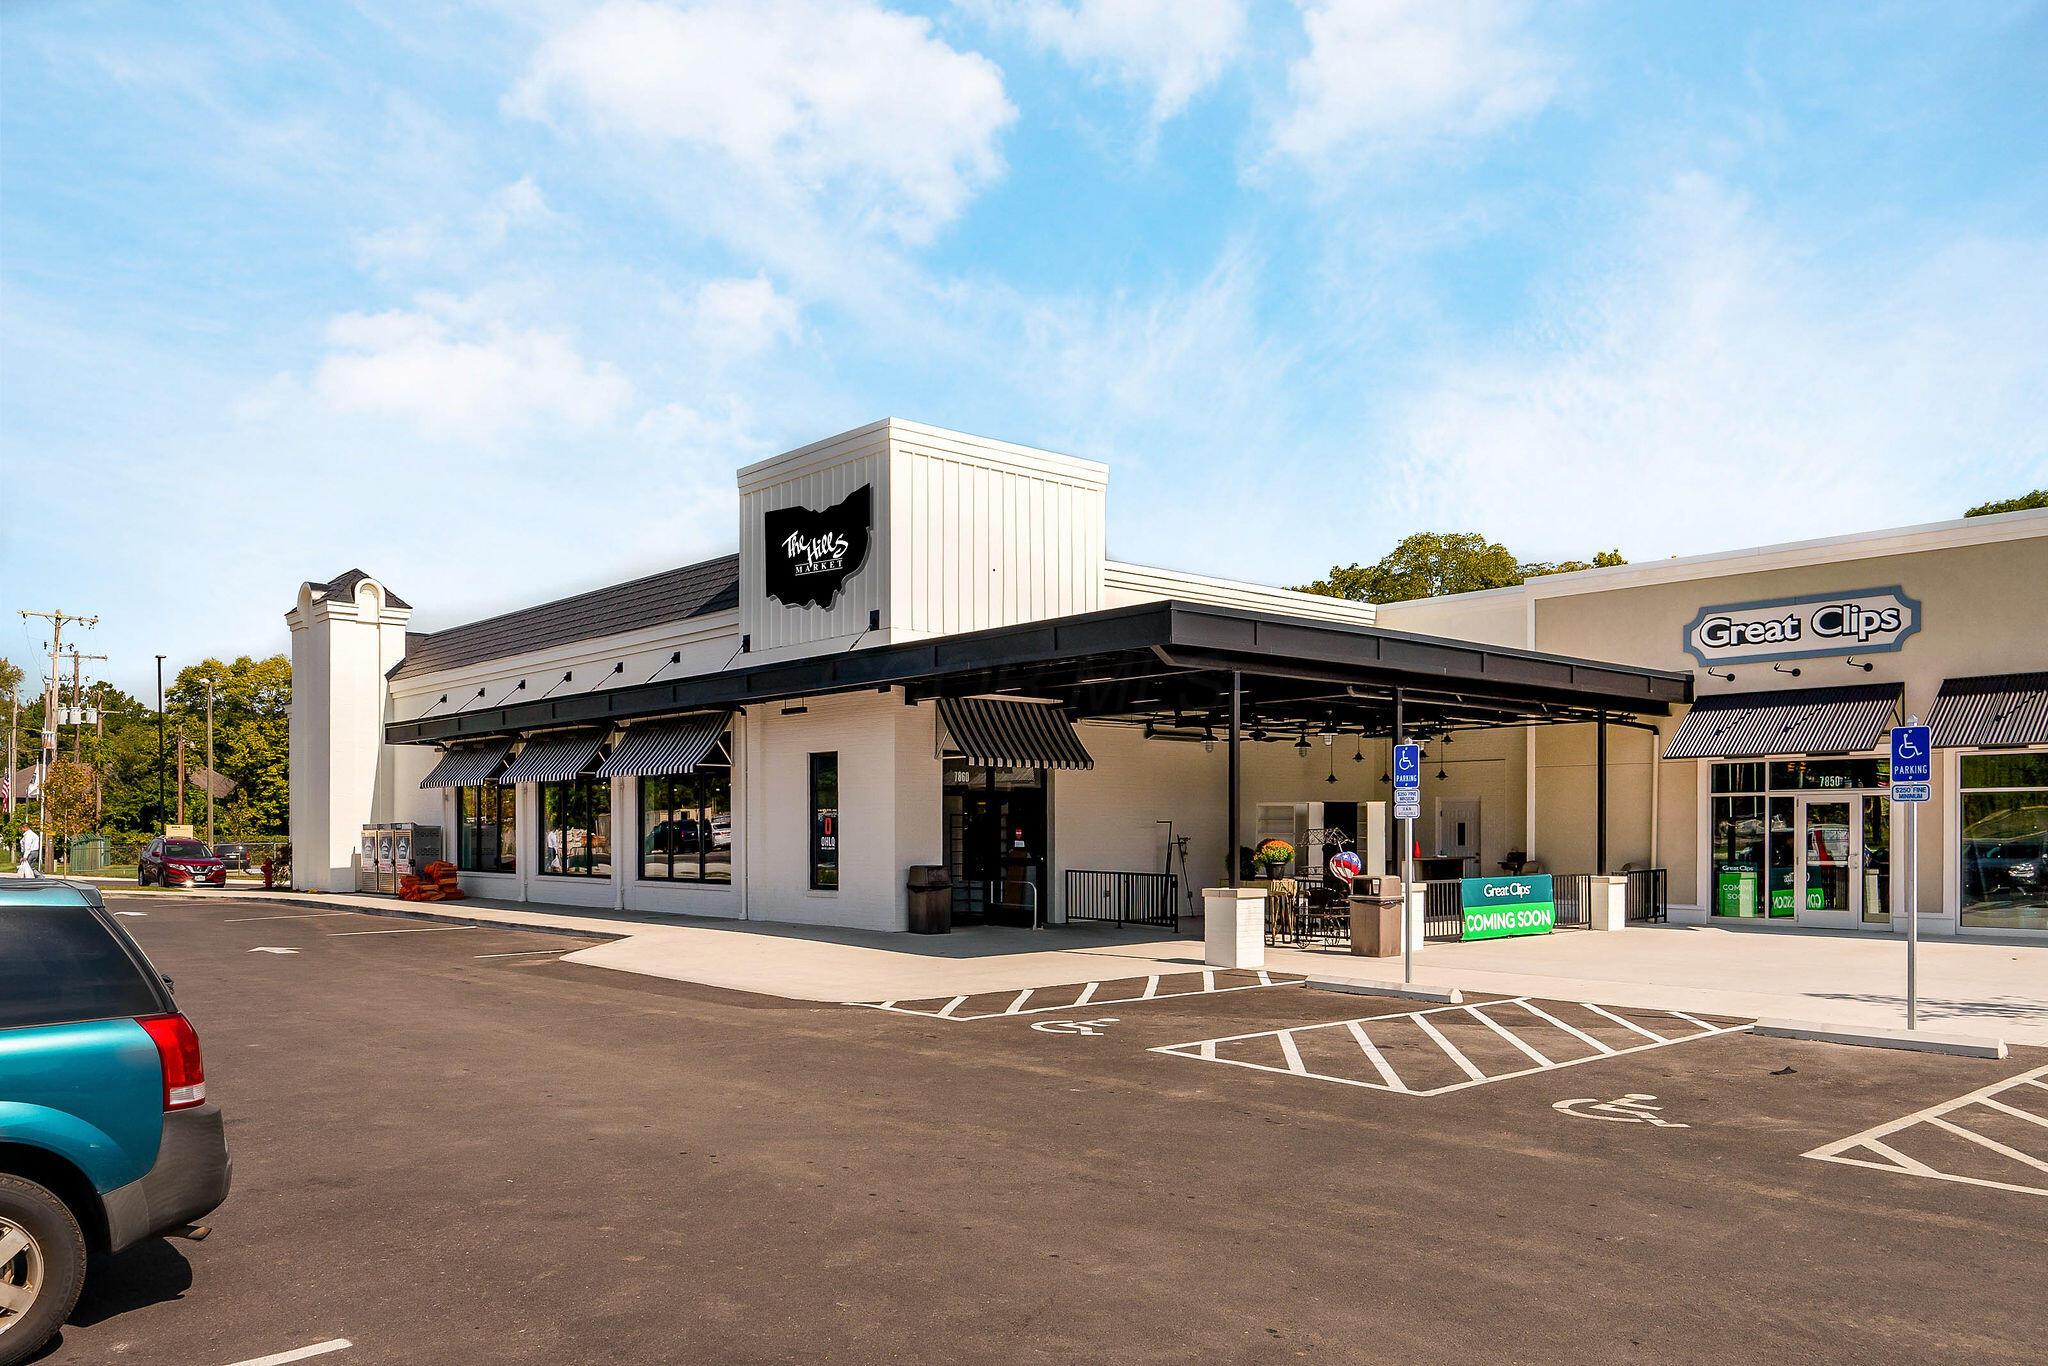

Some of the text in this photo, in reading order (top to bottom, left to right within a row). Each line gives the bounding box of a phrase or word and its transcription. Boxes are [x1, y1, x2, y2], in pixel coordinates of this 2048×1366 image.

[781, 530, 849, 568] The Hills
[794, 559, 843, 574] MARKET
[1699, 603, 1902, 649] Great Clips
[954, 771, 970, 783] 7860
[1894, 765, 1928, 775] PARKING
[1396, 774, 1417, 782] PARKING
[1819, 775, 1840, 787] 7850
[1483, 882, 1532, 899] Great Clips
[1466, 909, 1552, 932] COMING SOON
